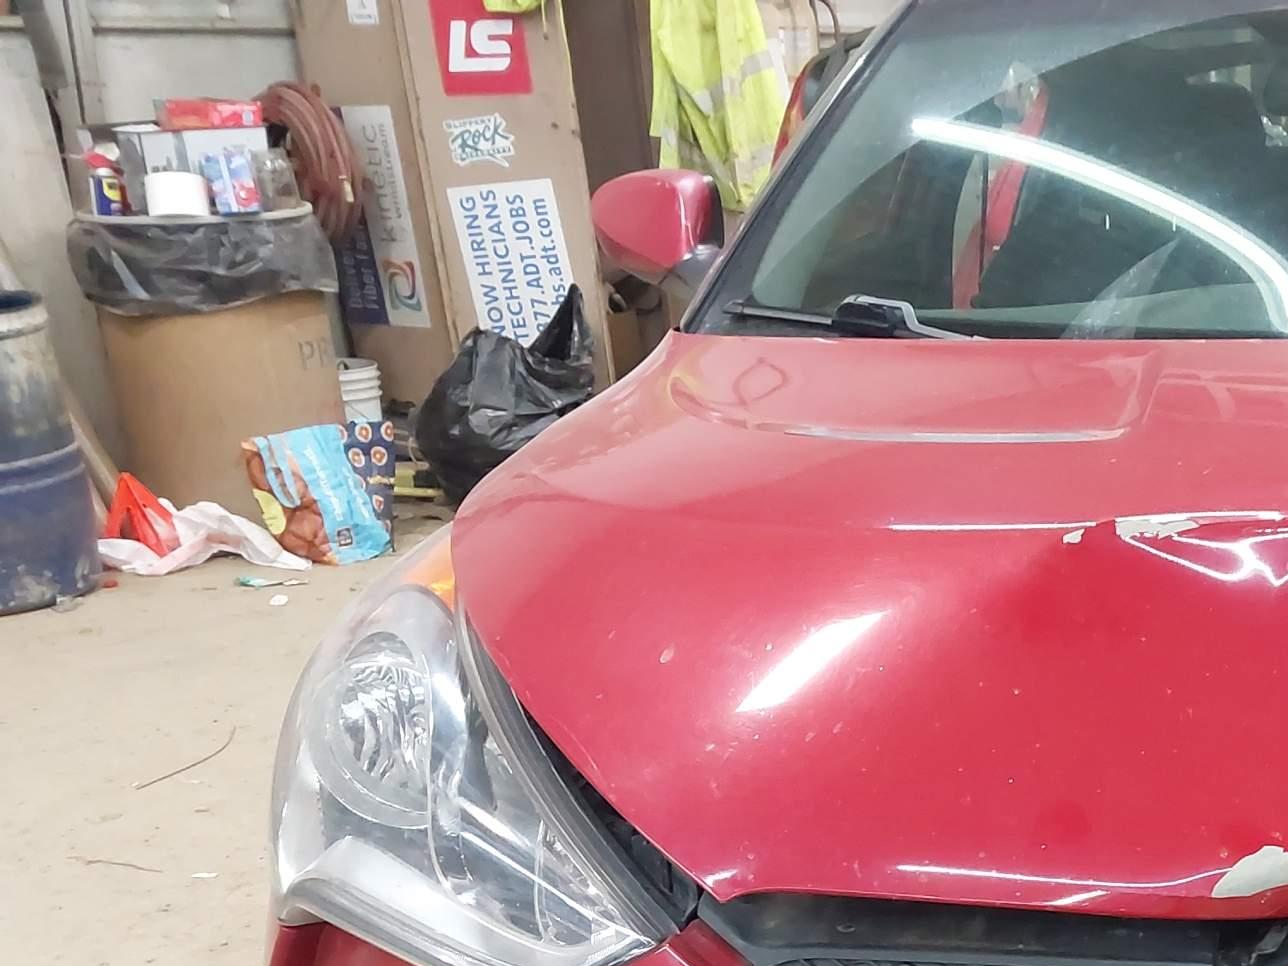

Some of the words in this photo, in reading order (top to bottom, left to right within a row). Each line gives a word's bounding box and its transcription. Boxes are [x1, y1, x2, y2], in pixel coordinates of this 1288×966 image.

[449, 19, 513, 73] LS
[459, 196, 493, 276] HIRING
[480, 189, 530, 341] TECHNICIANS
[532, 198, 567, 306] bs.adt.com
[480, 284, 506, 336] NOW
